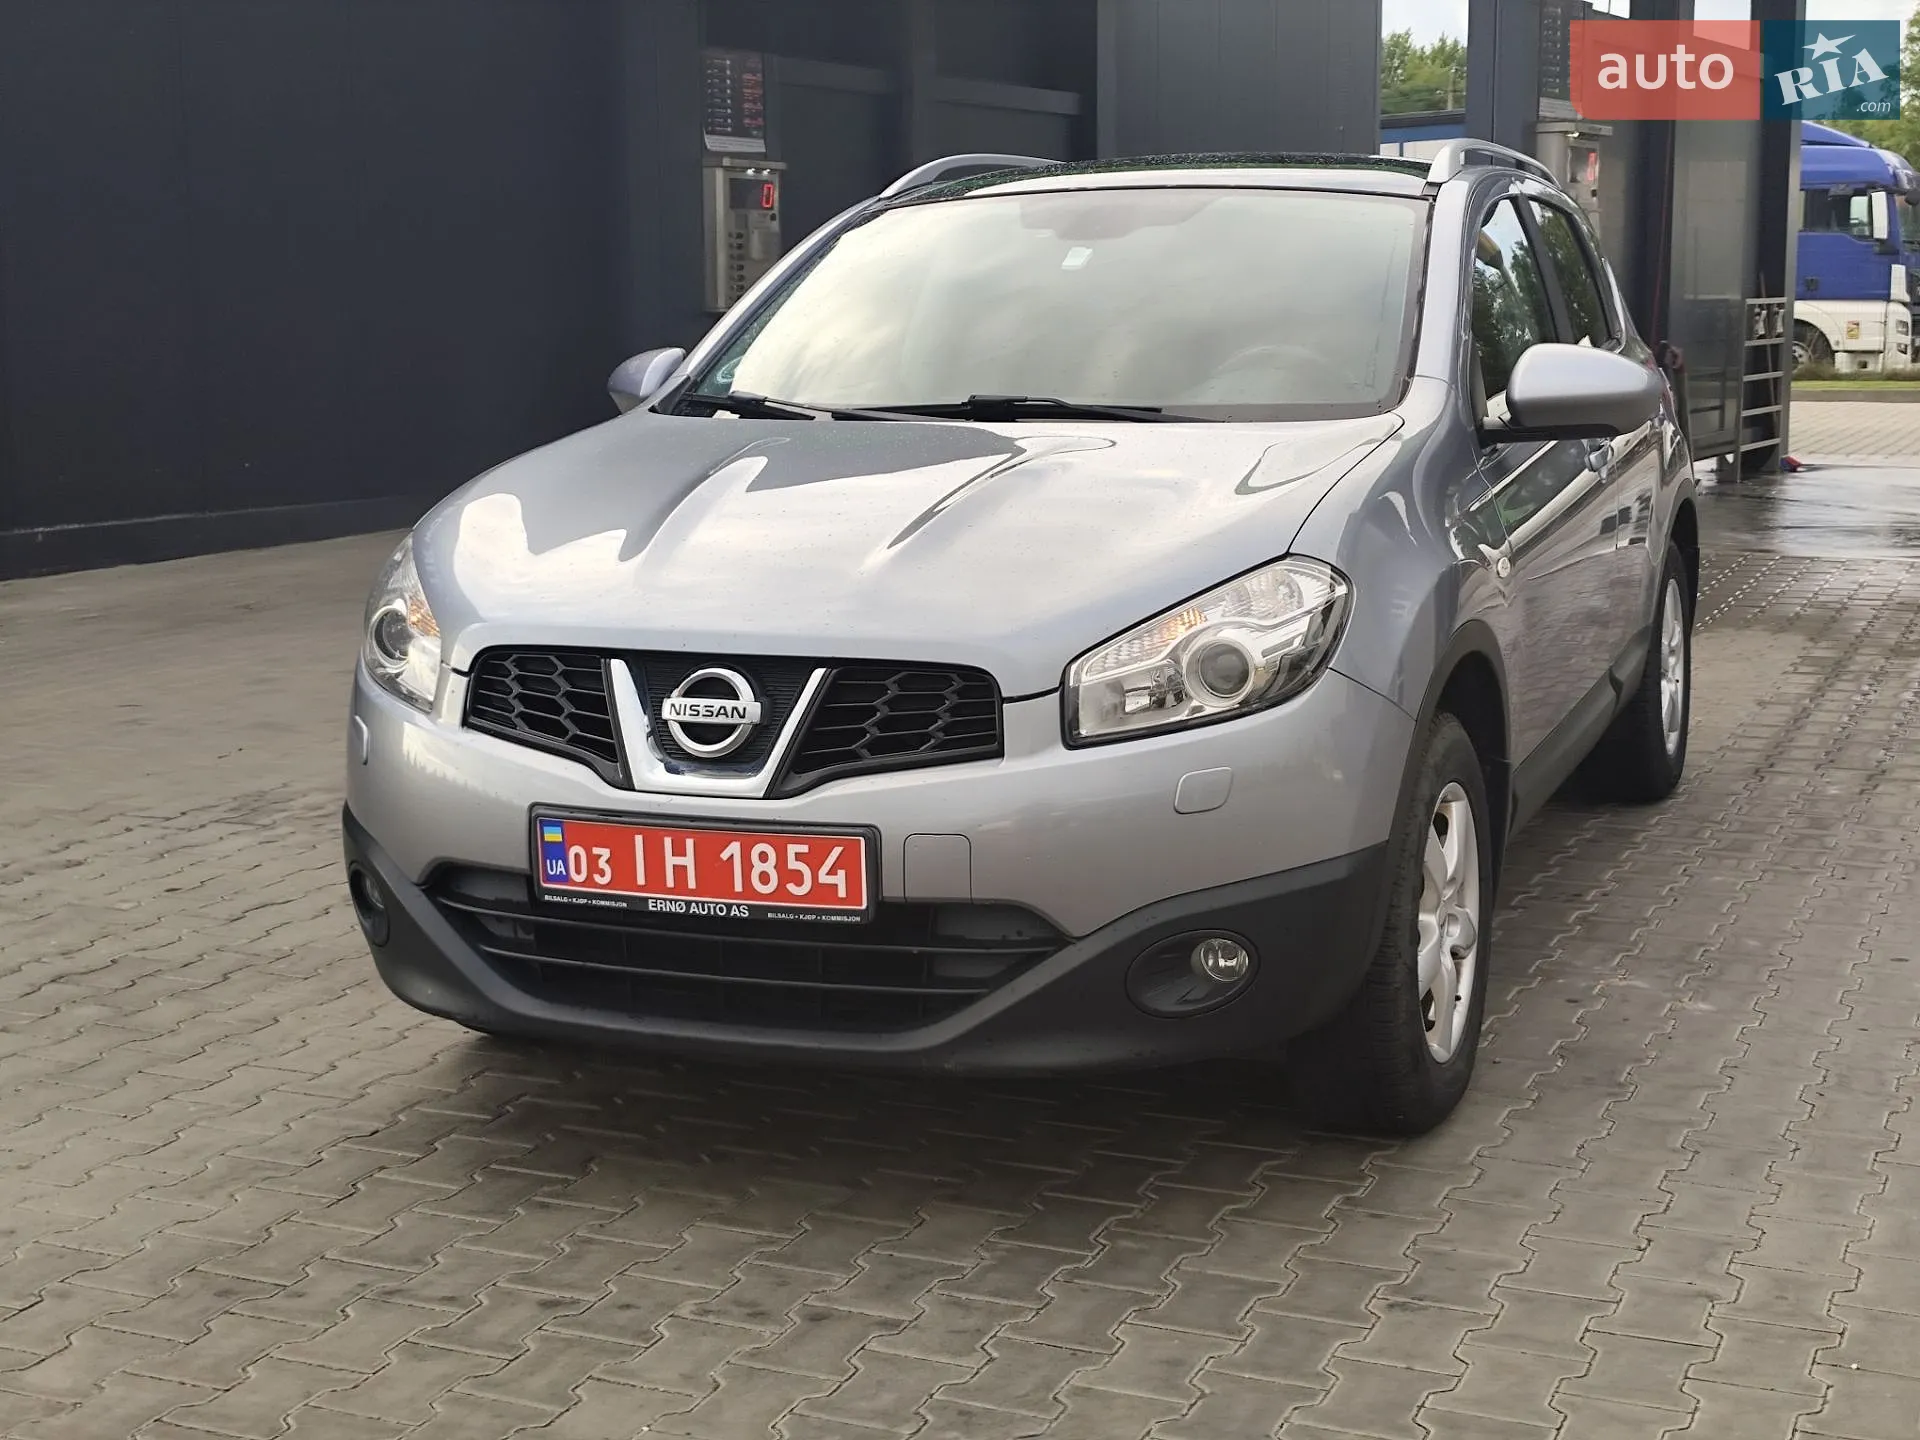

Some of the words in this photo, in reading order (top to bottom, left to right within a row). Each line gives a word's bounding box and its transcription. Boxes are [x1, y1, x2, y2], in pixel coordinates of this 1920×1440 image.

[669, 703, 747, 719] NISSAN
[546, 858, 567, 876] UA
[568, 844, 613, 886] 03
[719, 840, 848, 898] 1854
[648, 898, 687, 913] ERNØ
[689, 902, 727, 916] AUTO
[730, 904, 750, 918] AS
[767, 912, 794, 920] BILSALG
